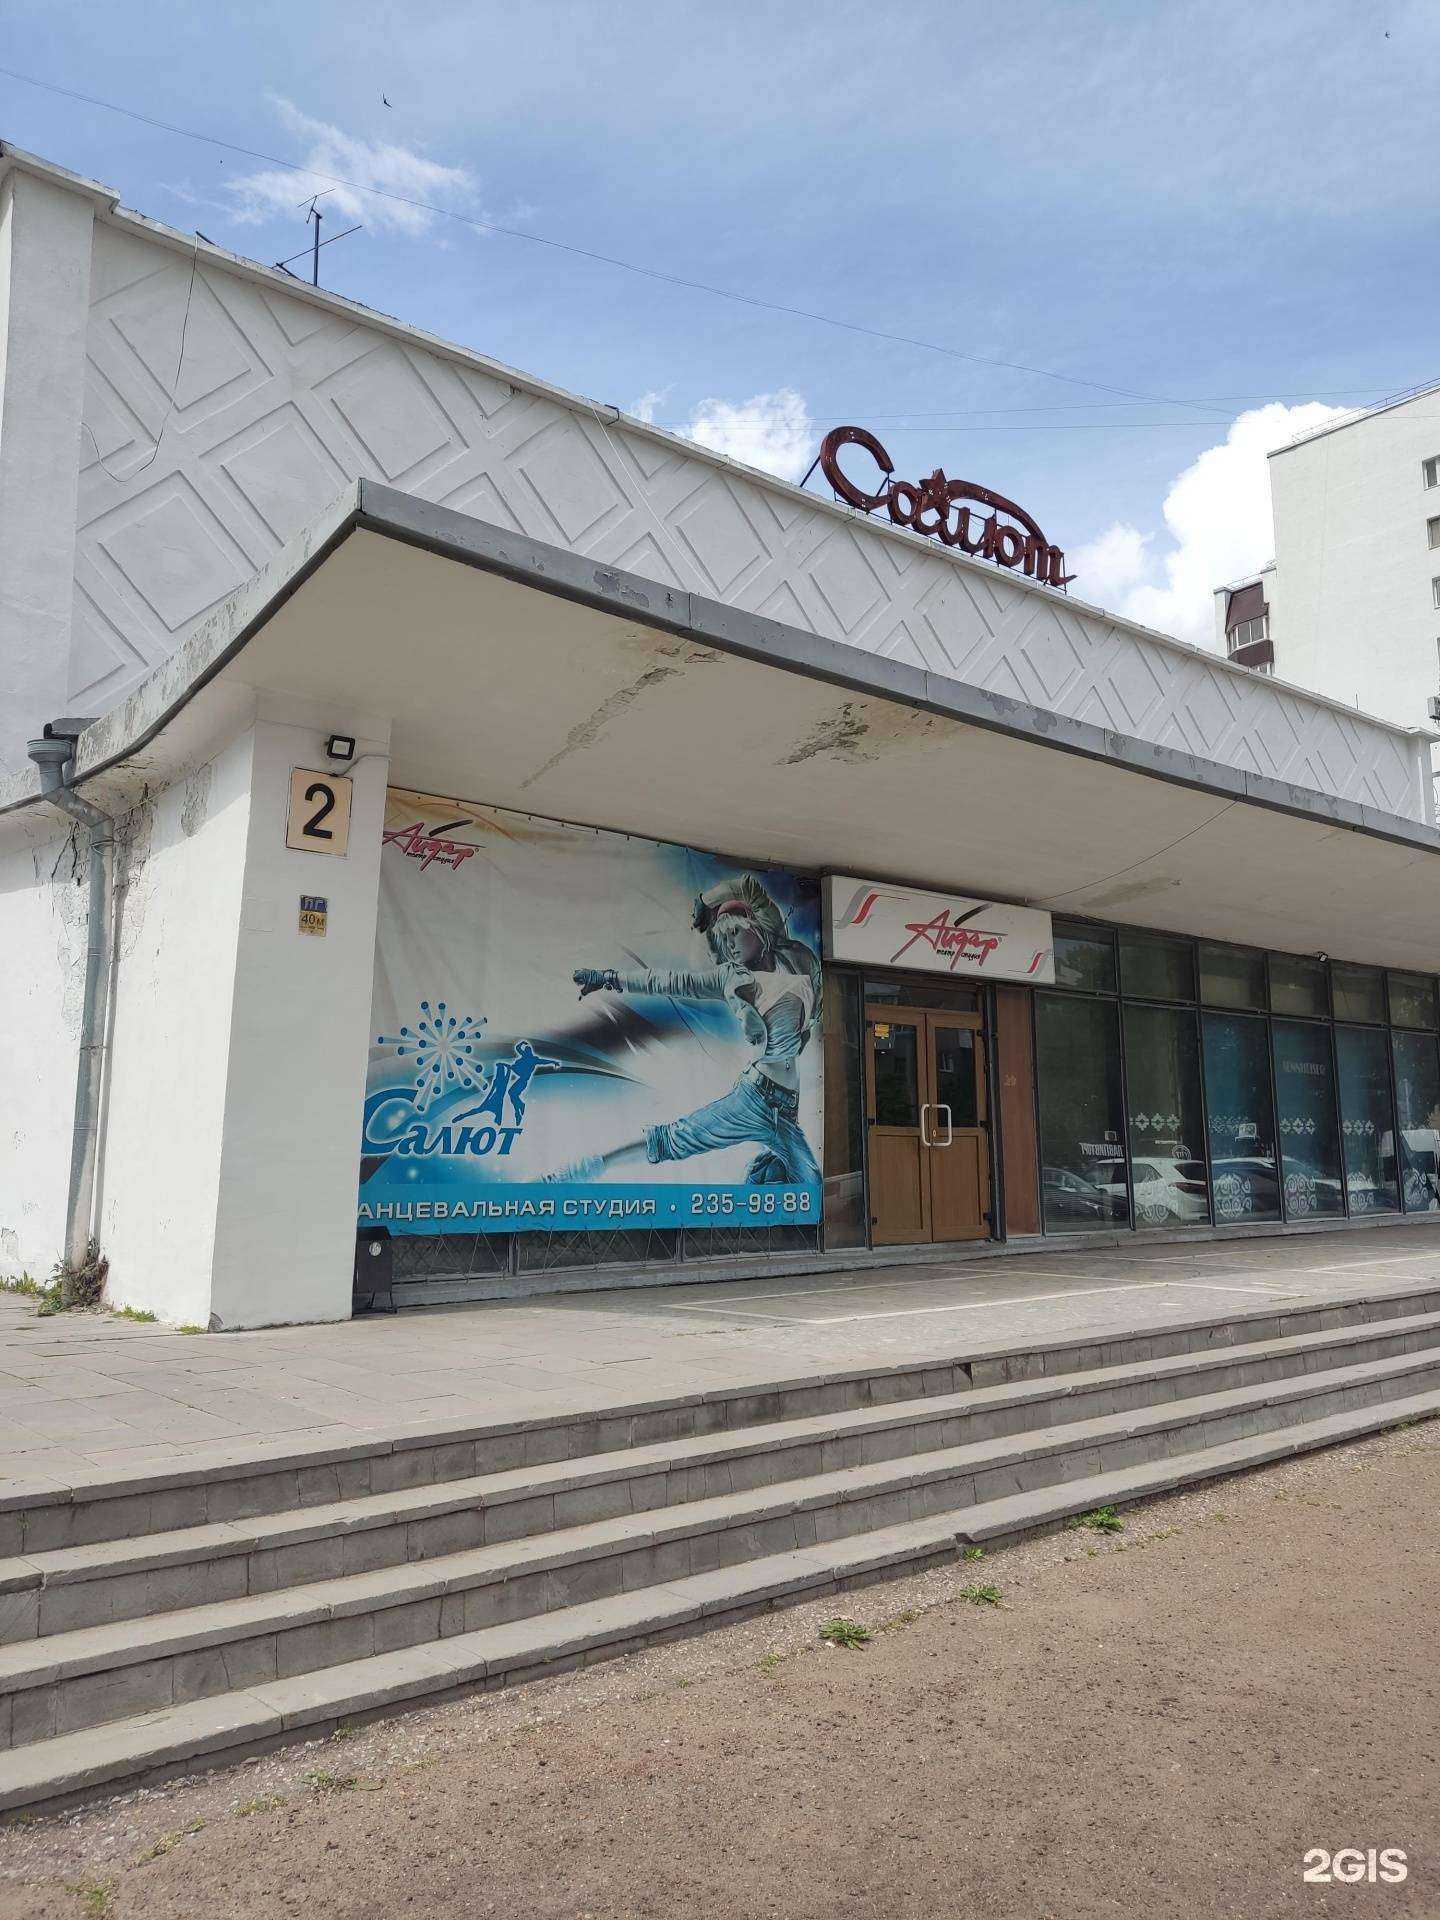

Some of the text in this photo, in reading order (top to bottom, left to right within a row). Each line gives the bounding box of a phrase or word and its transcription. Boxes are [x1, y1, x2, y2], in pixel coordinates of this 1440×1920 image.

[820, 425, 1078, 587] Салют
[302, 782, 336, 840] 2
[361, 1088, 523, 1155] Салют
[357, 1192, 811, 1221] АНЦЕВАЛЬНАЯ СТУДИЯ 235-98-88
